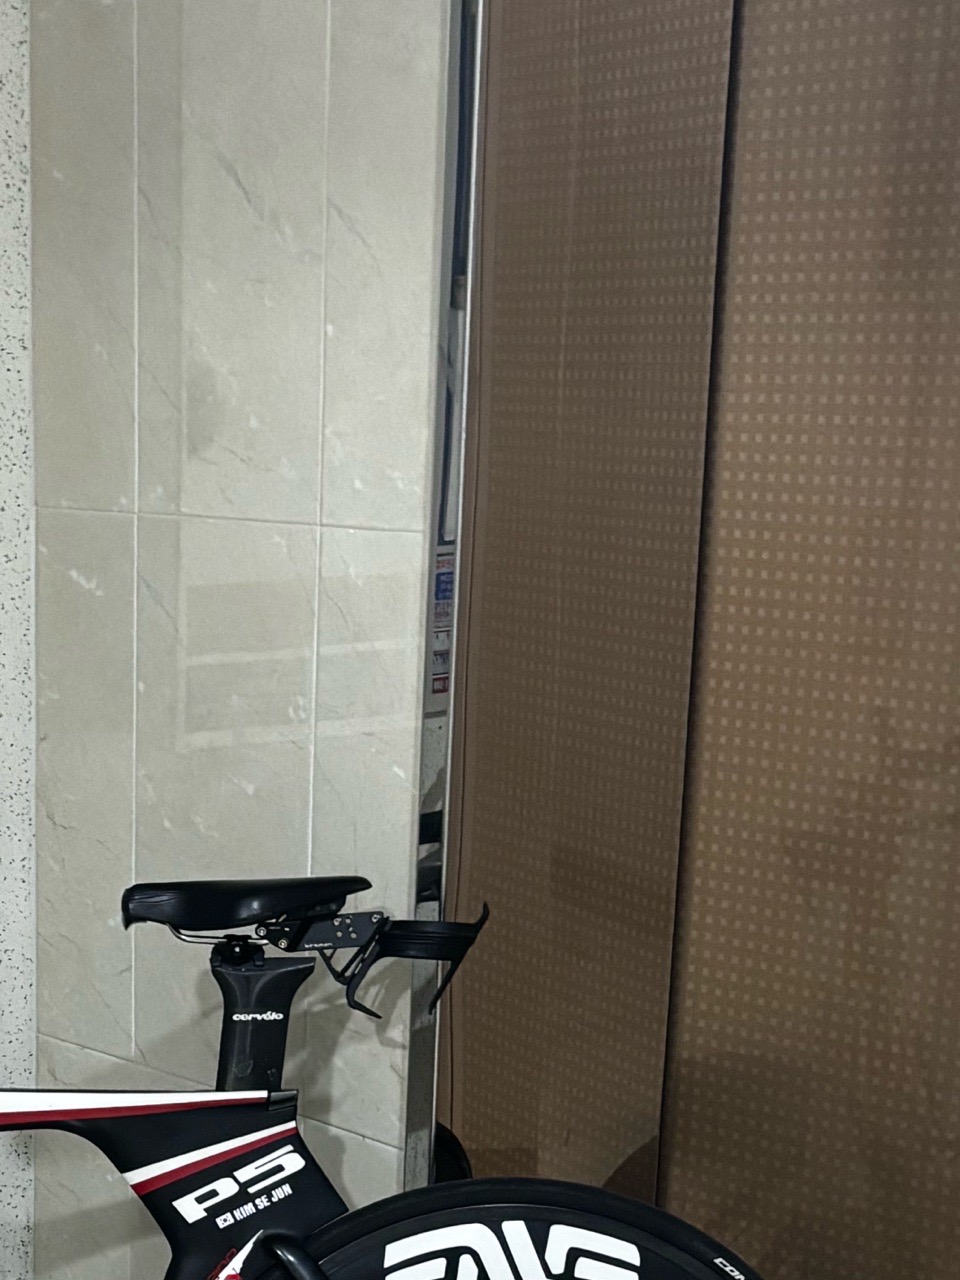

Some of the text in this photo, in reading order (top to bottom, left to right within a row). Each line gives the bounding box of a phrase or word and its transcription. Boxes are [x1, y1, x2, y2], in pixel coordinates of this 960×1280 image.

[232, 1011, 283, 1021] cervélo
[171, 1144, 306, 1224] P5
[233, 1183, 293, 1221] KIM SE JUN
